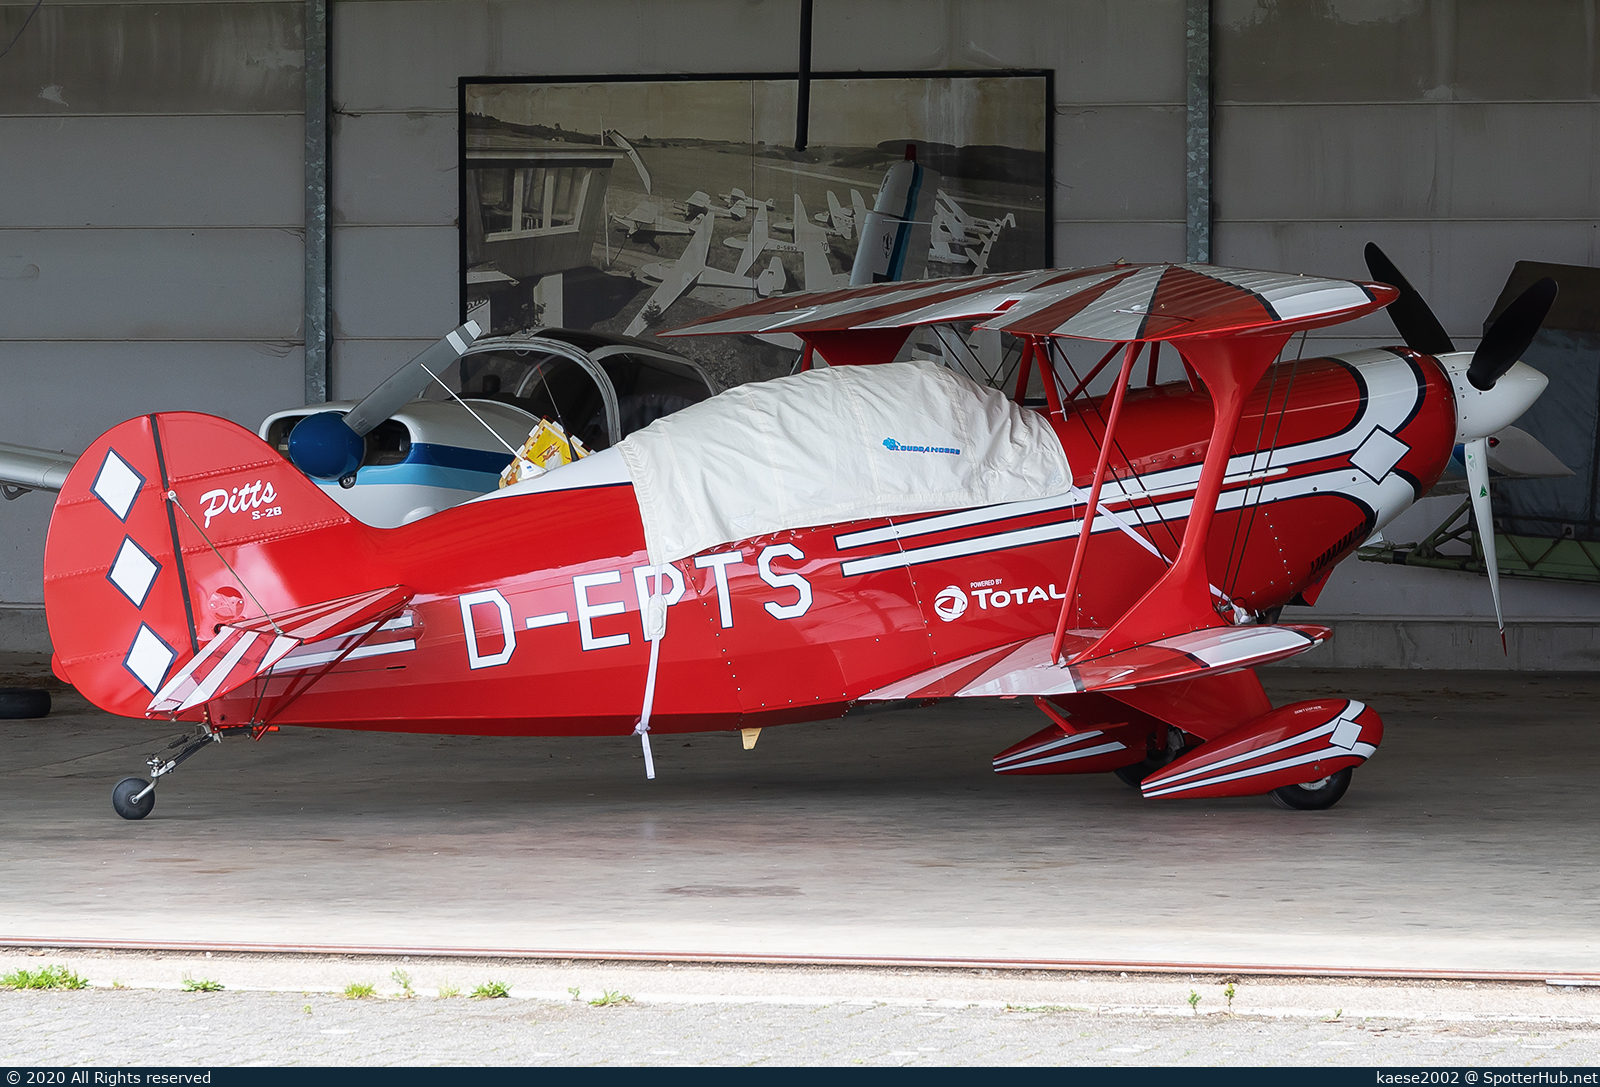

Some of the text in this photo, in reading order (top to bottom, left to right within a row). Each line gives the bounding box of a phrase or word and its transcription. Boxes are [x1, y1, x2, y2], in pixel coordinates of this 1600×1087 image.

[199, 479, 278, 529] Pitts
[251, 506, 283, 521] S-2B
[970, 577, 1003, 589] POWERED BY
[458, 542, 814, 671] D-EPTS
